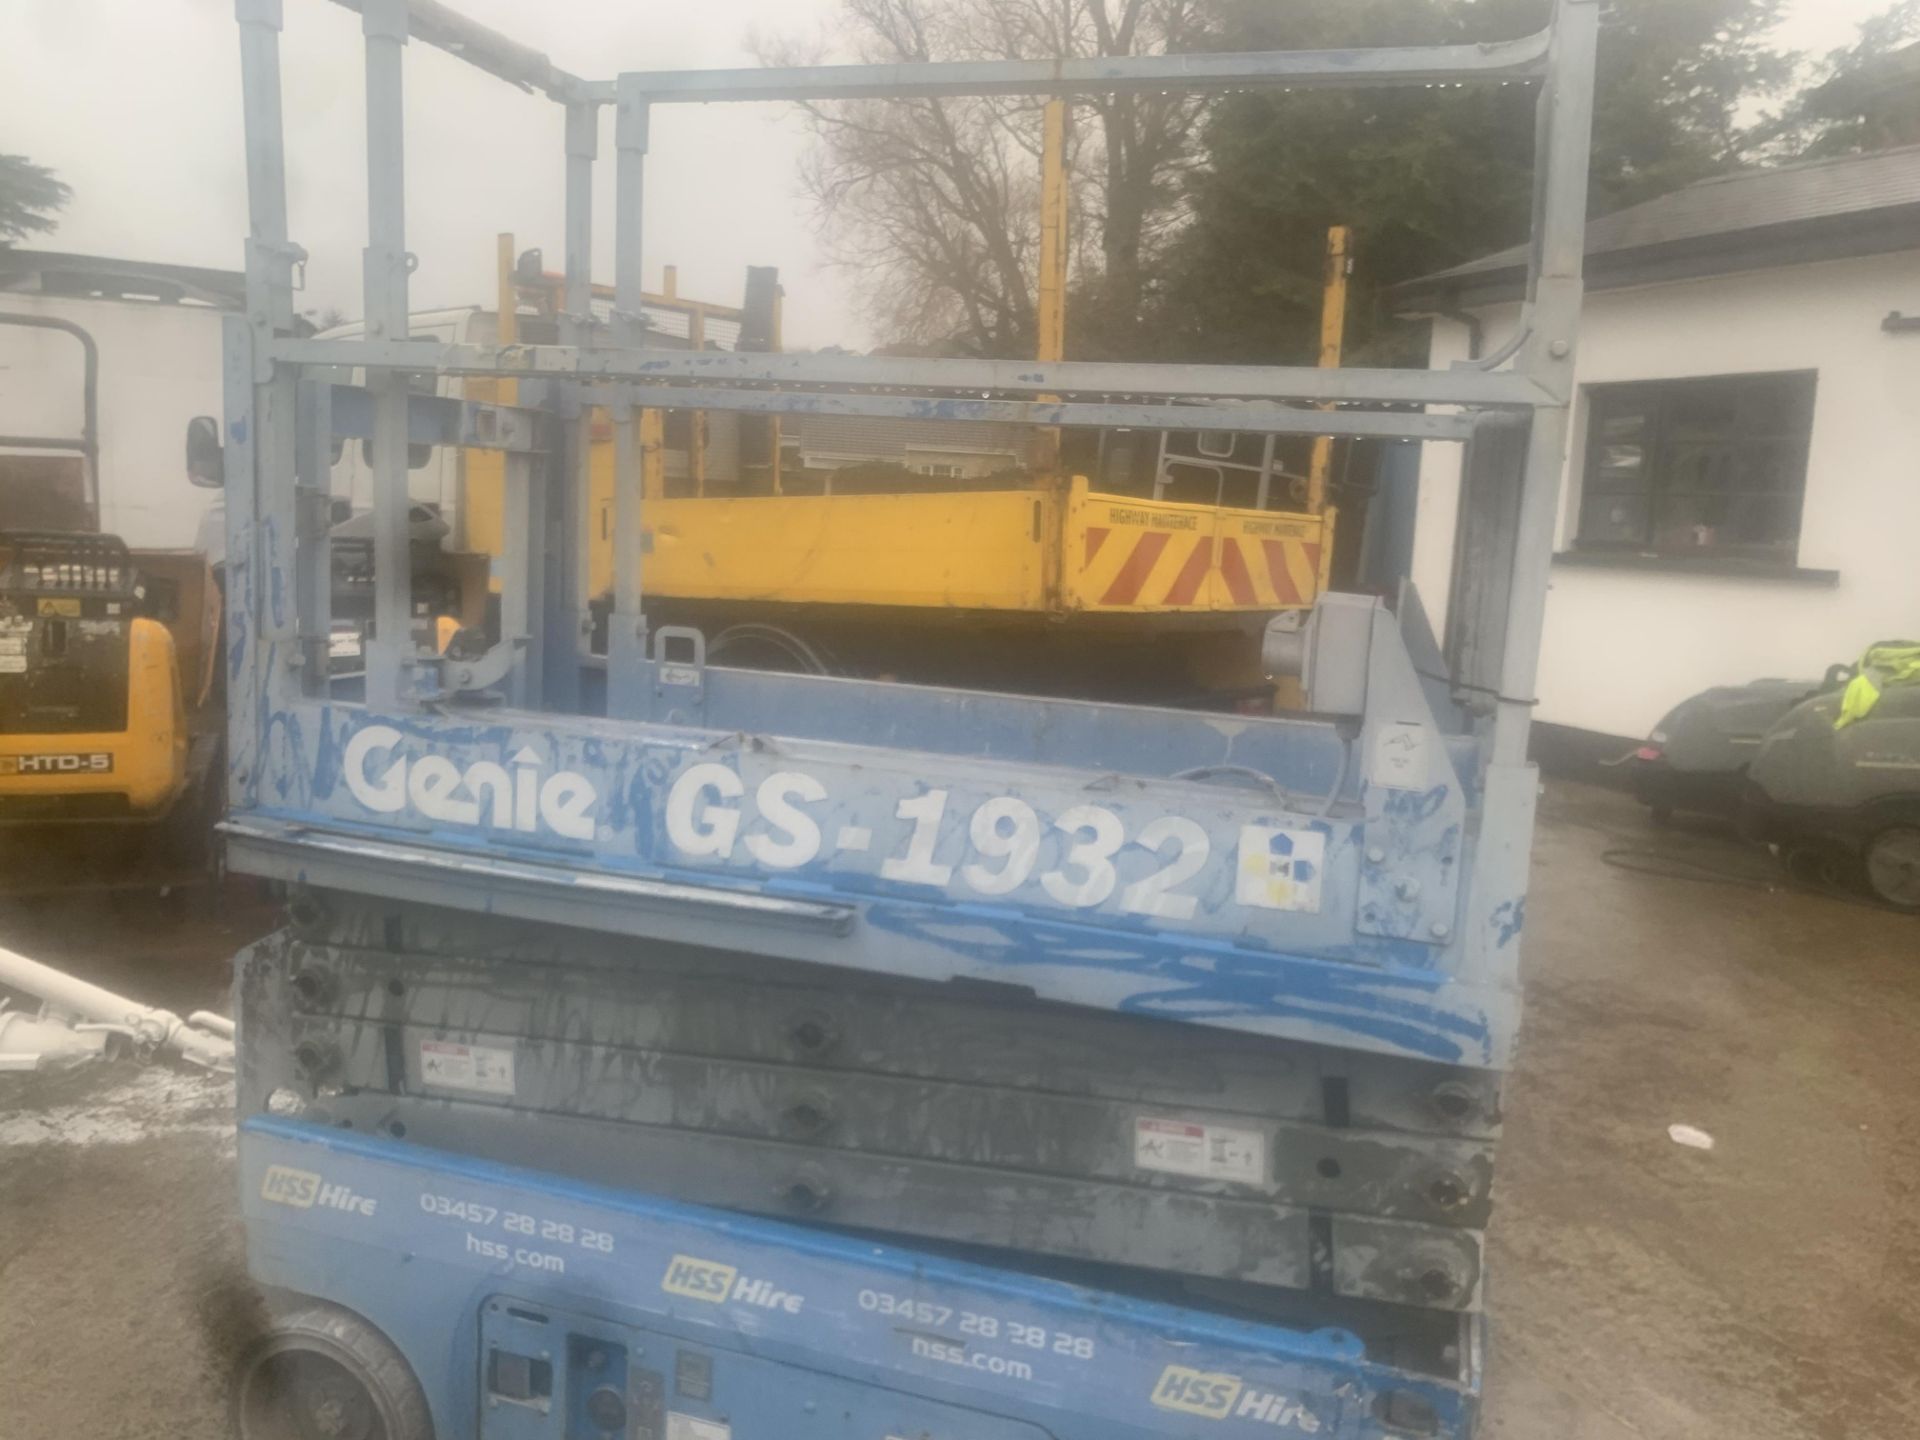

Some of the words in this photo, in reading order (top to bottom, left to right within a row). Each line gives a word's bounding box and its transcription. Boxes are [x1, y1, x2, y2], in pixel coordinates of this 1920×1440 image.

[1110, 508, 1150, 527] HIGHWAY
[19, 755, 109, 771] HTD-5
[666, 762, 1210, 920] GS-1932
[266, 1168, 317, 1203] HSS
[318, 1183, 377, 1216] Hire
[420, 1193, 498, 1226] 03457
[503, 1211, 536, 1235] 28
[541, 1219, 575, 1243] 28
[580, 1228, 614, 1252] 28
[466, 1232, 565, 1273] hss.com
[668, 1260, 729, 1294] HSS
[732, 1276, 804, 1315] Hire
[858, 1289, 952, 1326] 03457
[959, 1312, 999, 1338] 28
[1053, 1331, 1095, 1360] 28
[1159, 1372, 1233, 1410] HSS
